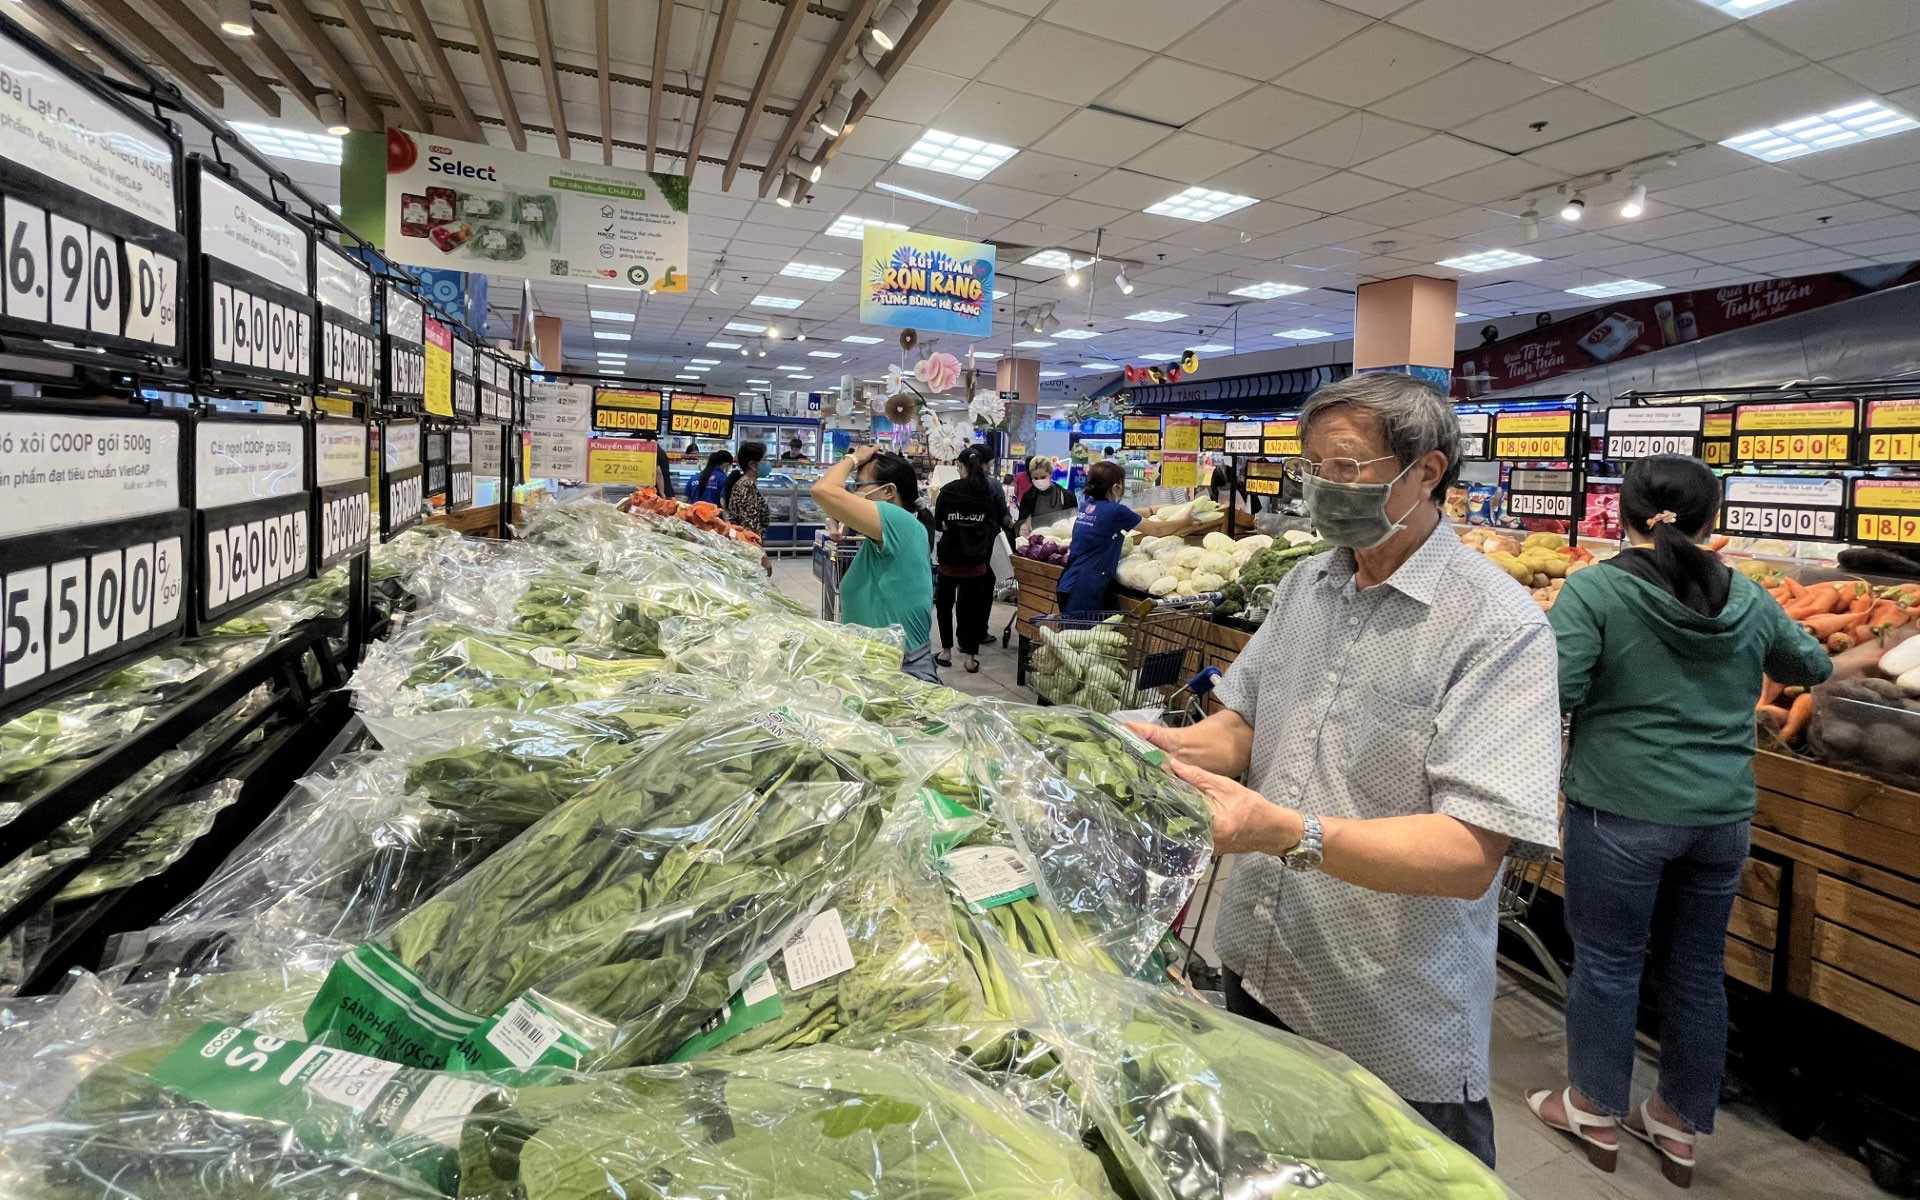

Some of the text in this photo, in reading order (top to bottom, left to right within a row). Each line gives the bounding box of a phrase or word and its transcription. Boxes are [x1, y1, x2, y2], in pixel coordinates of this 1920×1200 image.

[142, 159, 171, 189] 450g
[428, 156, 497, 182] Select
[929, 271, 982, 301] RÀNG
[952, 302, 980, 317] SANG
[219, 297, 295, 361] 16.000
[809, 402, 819, 410] 01
[599, 412, 646, 426] 21.500
[20, 432, 45, 454] xôi
[50, 433, 93, 453] COOP
[98, 434, 119, 456] gói
[124, 434, 151, 455] 500g
[243, 441, 264, 453] COOP
[1500, 440, 1550, 453] 18.900
[1611, 439, 1676, 455] 20.200
[1740, 438, 1824, 455] 33.500
[14, 467, 46, 488] phẩm
[49, 470, 65, 485] đạt
[119, 464, 150, 478] VietGAP
[1514, 497, 1566, 511] 21.500
[1730, 509, 1812, 530] 32.500
[1864, 518, 1917, 537] 18.9
[216, 525, 293, 591] 16.000
[5, 557, 149, 665] 5.500
[341, 996, 367, 1020] SẢN
[203, 1028, 236, 1056] COOP
